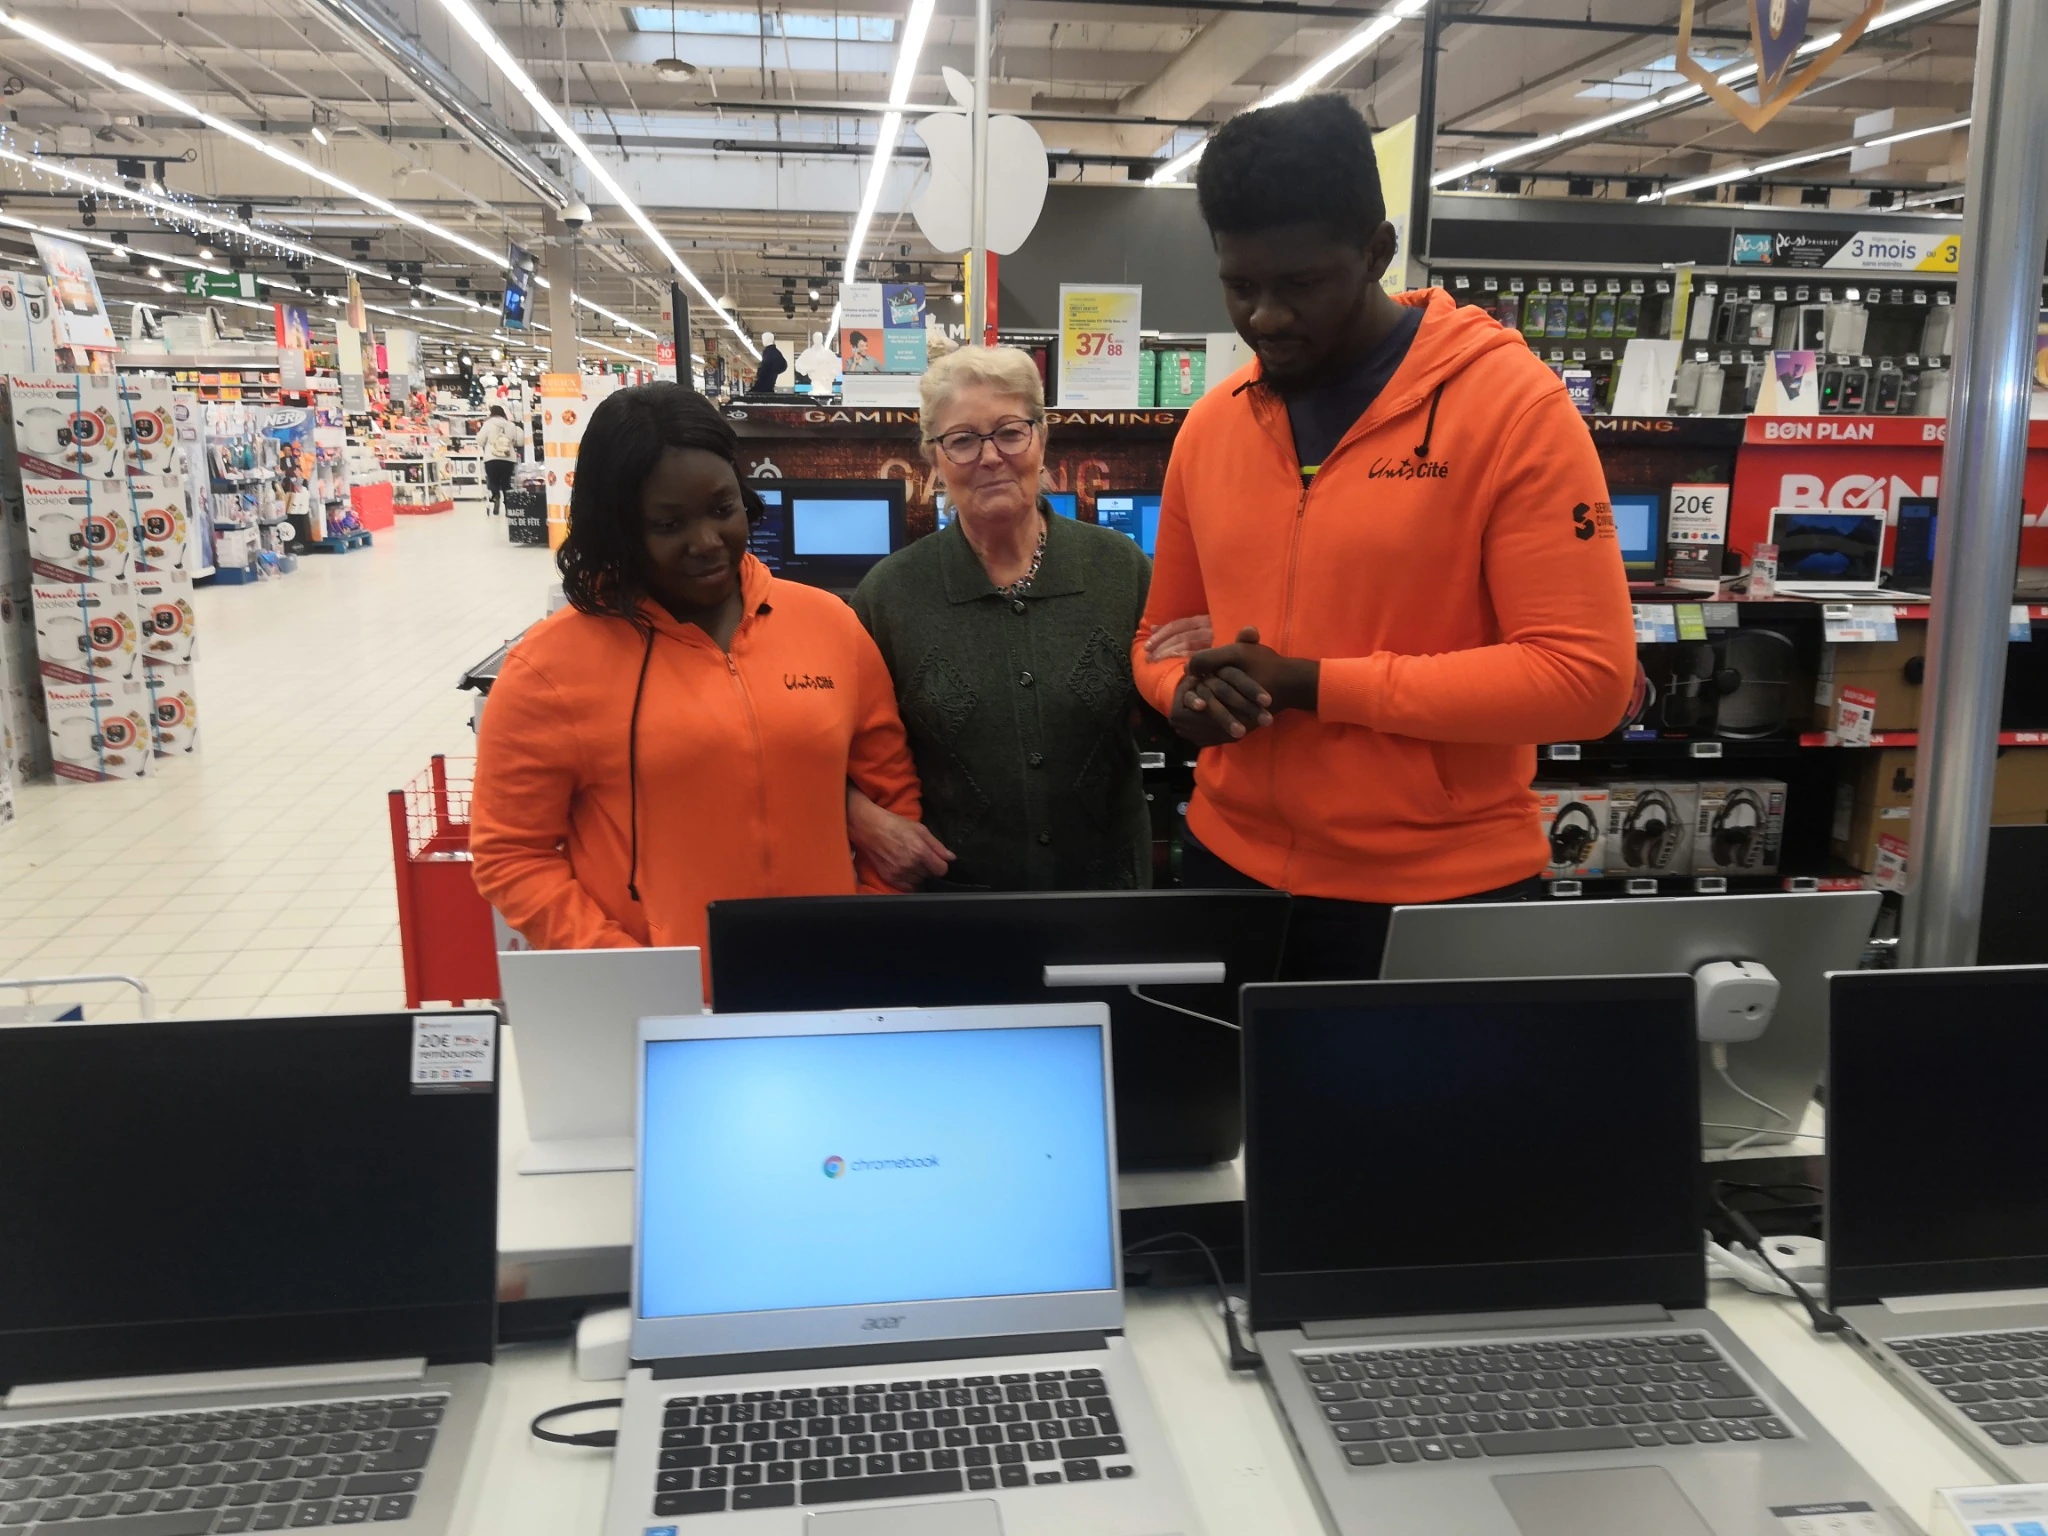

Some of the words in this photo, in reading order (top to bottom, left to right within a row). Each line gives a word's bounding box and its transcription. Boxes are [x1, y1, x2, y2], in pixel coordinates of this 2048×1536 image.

[1852, 239, 1864, 258] 3
[1868, 239, 1917, 259] mois
[1945, 245, 1958, 263] 3
[1076, 332, 1107, 356] 37
[1107, 344, 1123, 357] 88
[1569, 387, 1590, 398] 30€
[804, 410, 920, 424] GAMIN
[1044, 412, 1175, 425] GAMING
[1594, 418, 1674, 432] MING
[1765, 422, 1813, 440] BON
[1816, 422, 1875, 441] PLAN
[1922, 423, 1947, 442] BO
[1416, 461, 1449, 478] Cité
[1673, 495, 1715, 514] 20€
[851, 1154, 940, 1171] chromebook
[859, 1316, 908, 1331] acer
